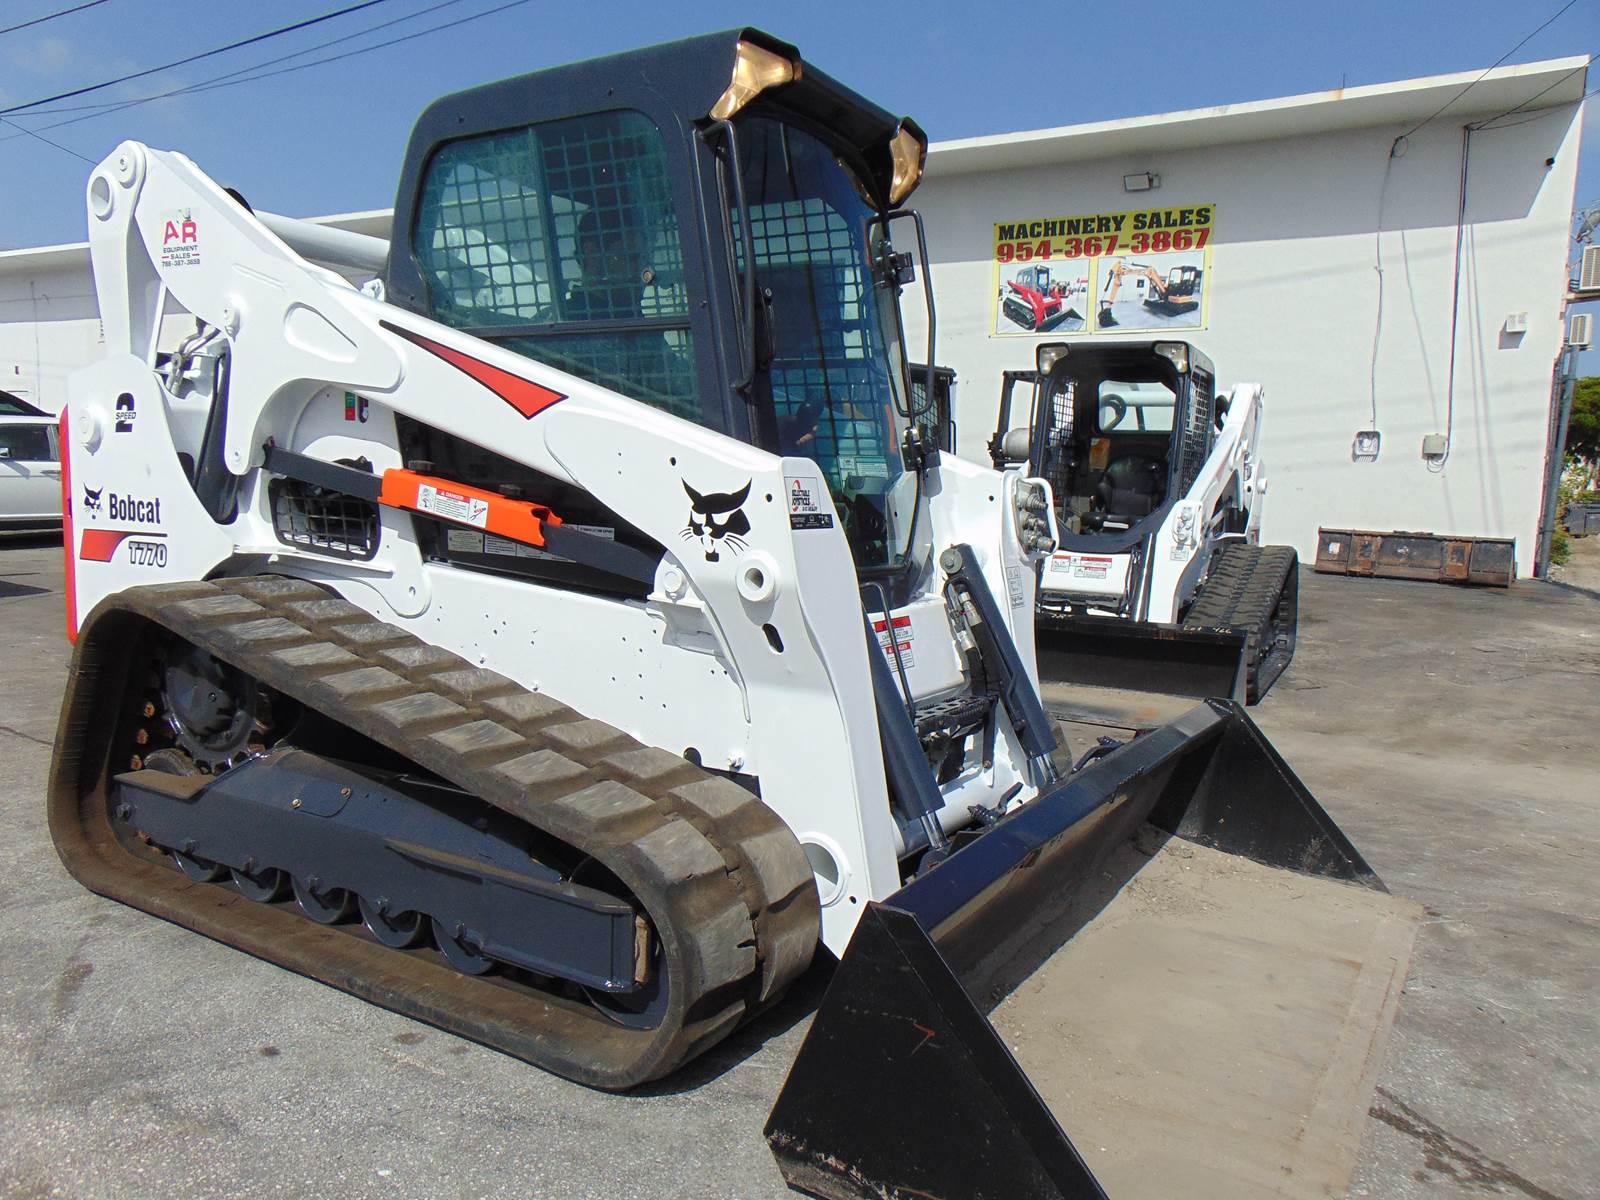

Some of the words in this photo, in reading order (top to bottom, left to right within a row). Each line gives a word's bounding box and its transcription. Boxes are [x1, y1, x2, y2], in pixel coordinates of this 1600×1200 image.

[998, 215, 1126, 241] MACHINERY
[1133, 207, 1211, 230] SALES
[163, 245, 198, 253] EQUIPMENT
[170, 252, 191, 260] SALES
[996, 227, 1211, 263] 954-367-3867
[115, 392, 135, 433] 2
[115, 411, 137, 420] SPEED
[109, 493, 161, 524] Bobcat
[128, 541, 168, 568] T770
